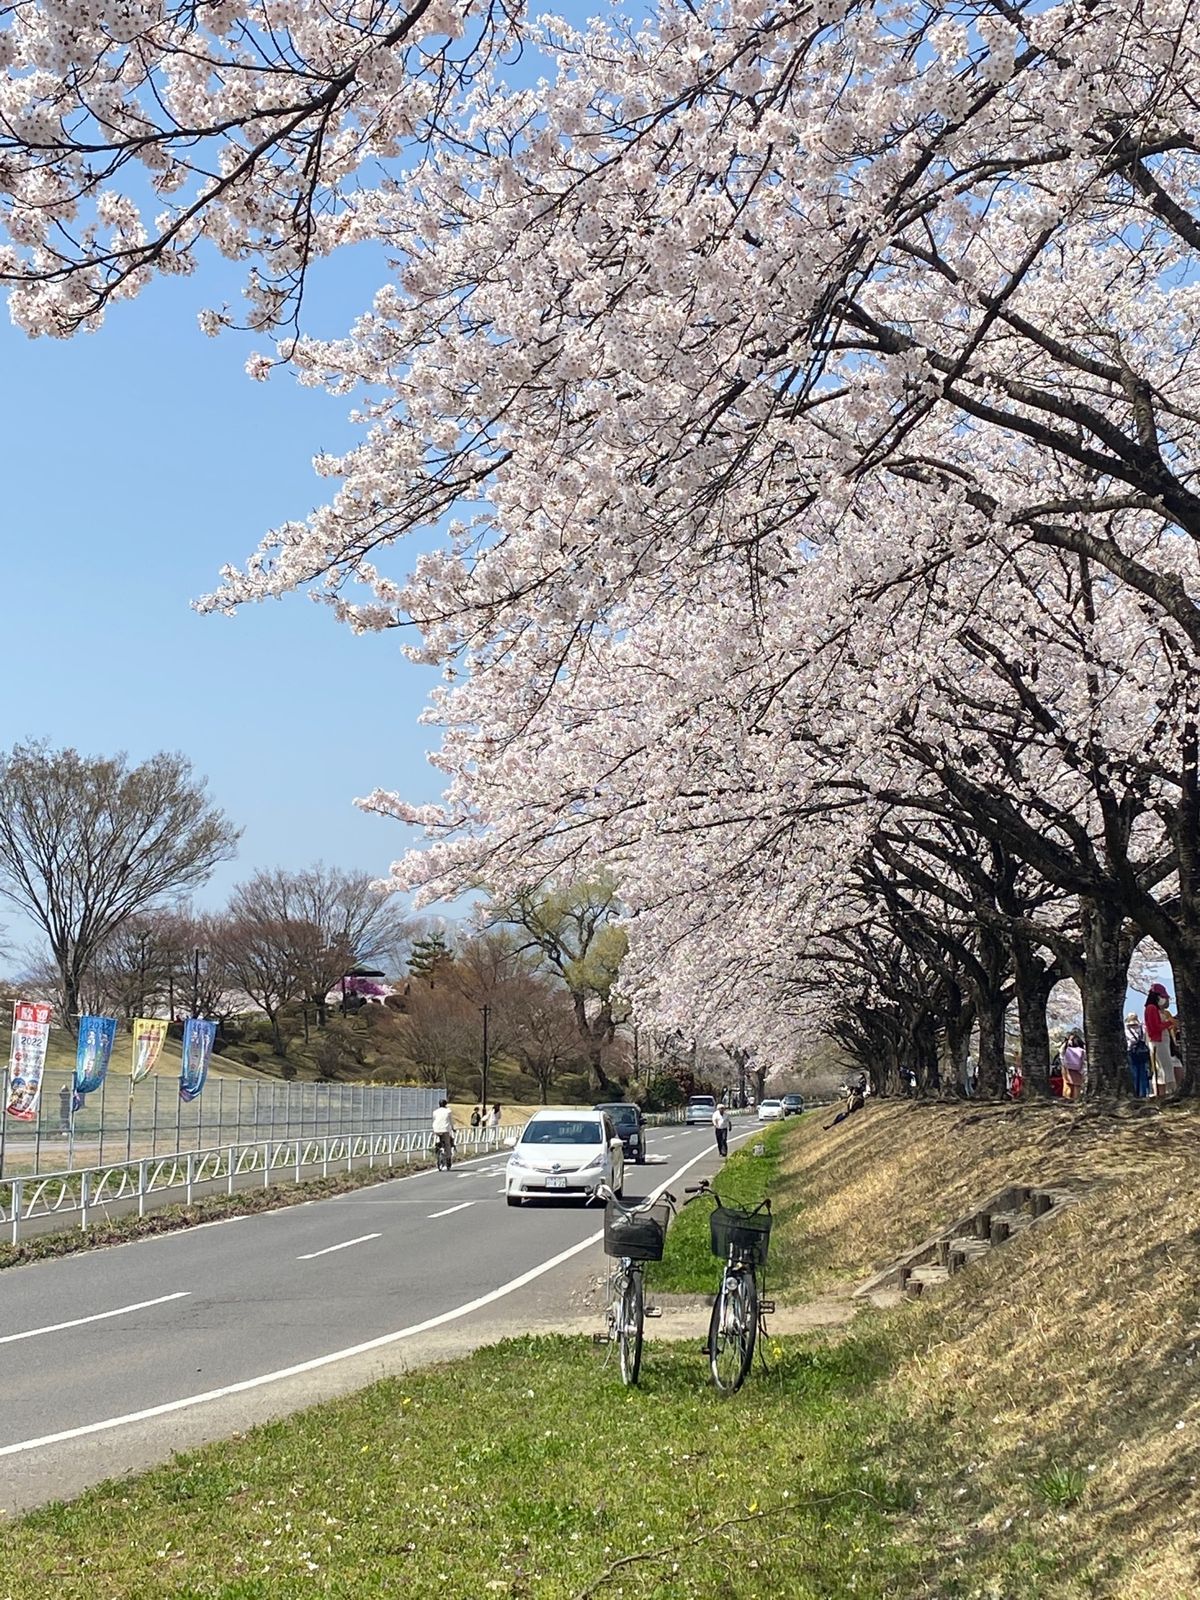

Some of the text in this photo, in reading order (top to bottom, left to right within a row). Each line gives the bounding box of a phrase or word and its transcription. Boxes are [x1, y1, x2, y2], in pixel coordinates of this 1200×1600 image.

[20, 1006, 48, 1023] 歓迎
[90, 1021, 111, 1030] 2022
[20, 1036, 42, 1047] 2022
